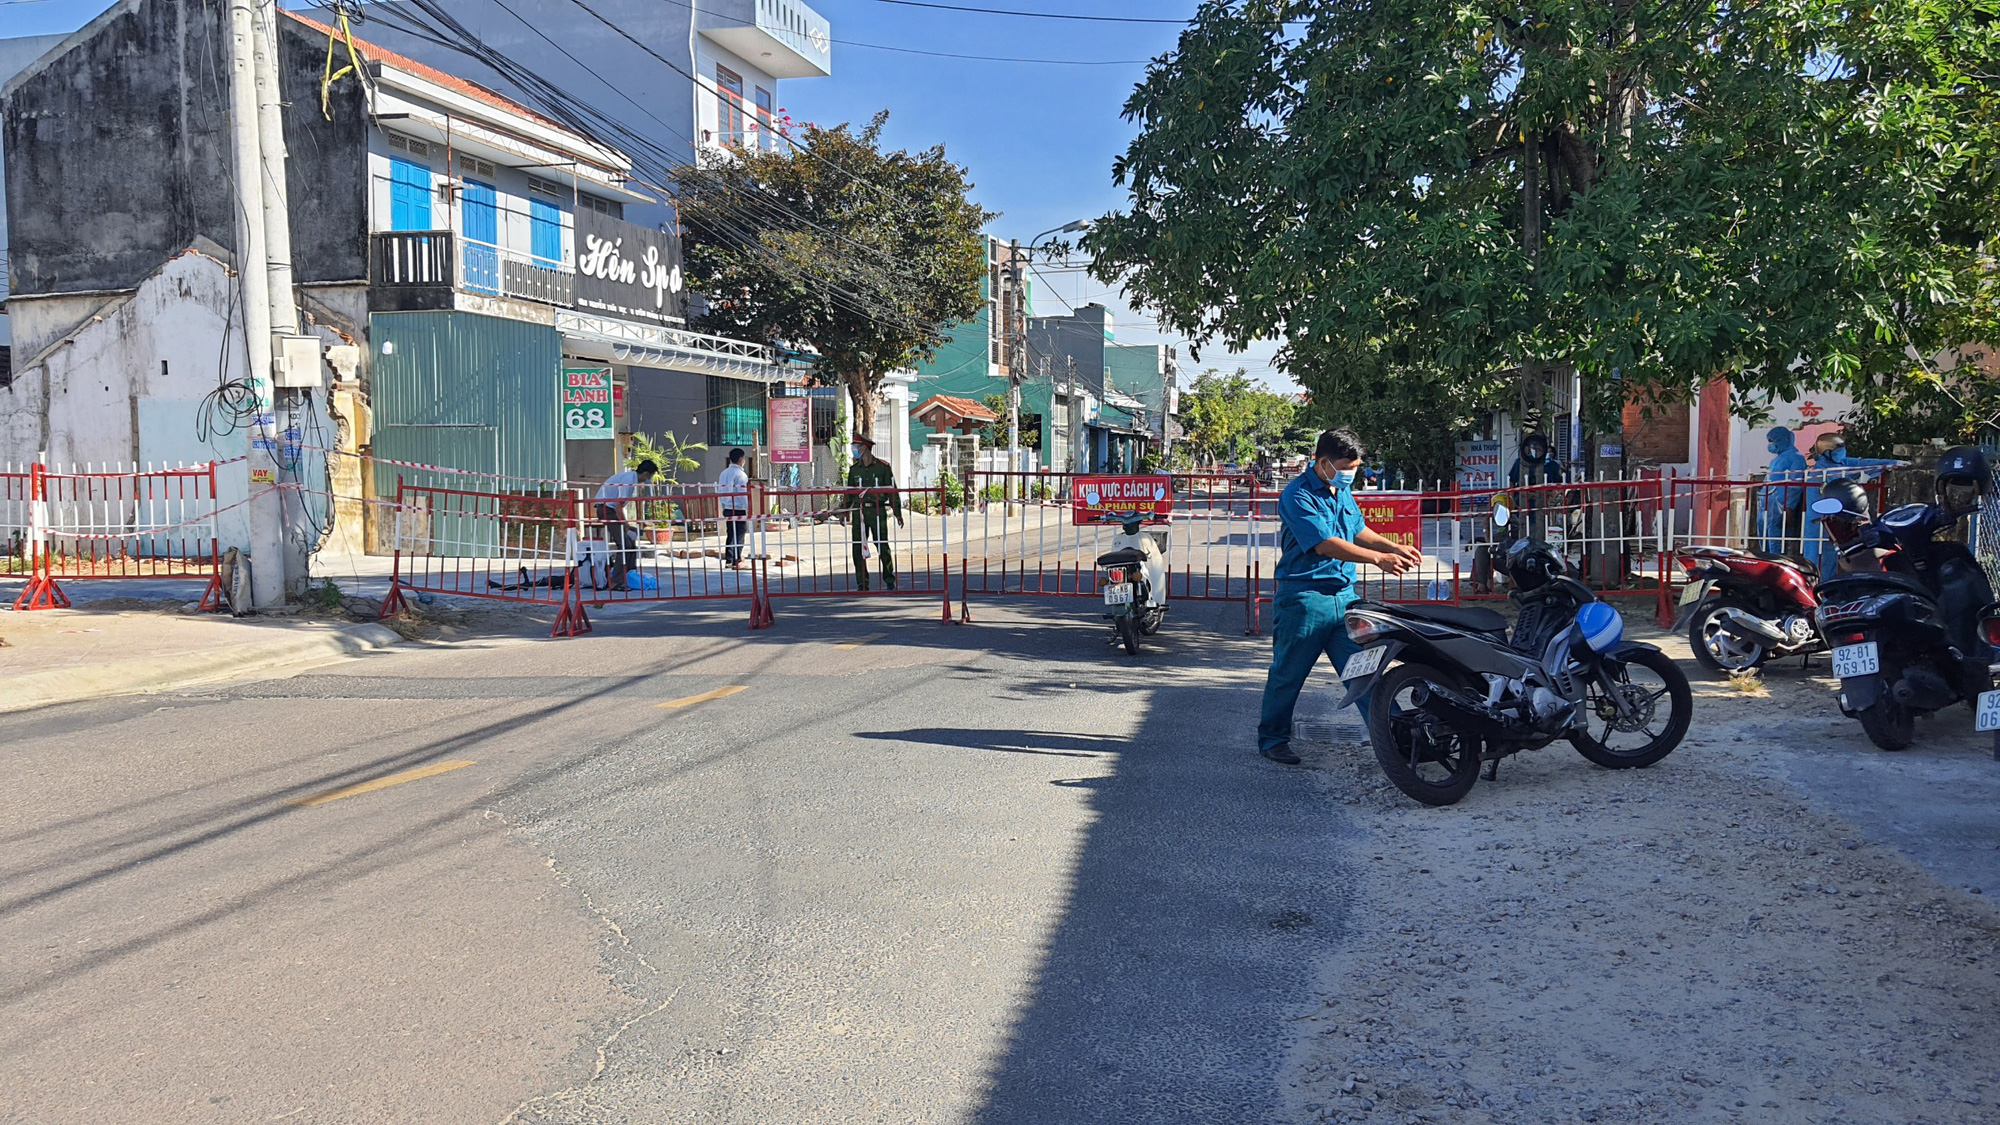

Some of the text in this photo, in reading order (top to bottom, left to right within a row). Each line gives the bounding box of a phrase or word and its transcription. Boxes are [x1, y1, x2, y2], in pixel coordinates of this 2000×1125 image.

[579, 233, 683, 309] Hến Spa
[567, 373, 603, 388] BIA
[563, 388, 609, 407] LẠNH
[566, 408, 606, 429] 68
[1461, 454, 1498, 465] MINH
[252, 469, 268, 477] VAY
[1463, 469, 1496, 482] TÂM
[1079, 484, 1099, 498] KHU
[1101, 482, 1121, 500] VỰC
[1123, 480, 1150, 498] CÁCH
[1368, 504, 1394, 526] CHẶN
[1108, 593, 1129, 603] 0967
[1838, 645, 1870, 661] 92-B1
[1835, 658, 1876, 676] 269.15
